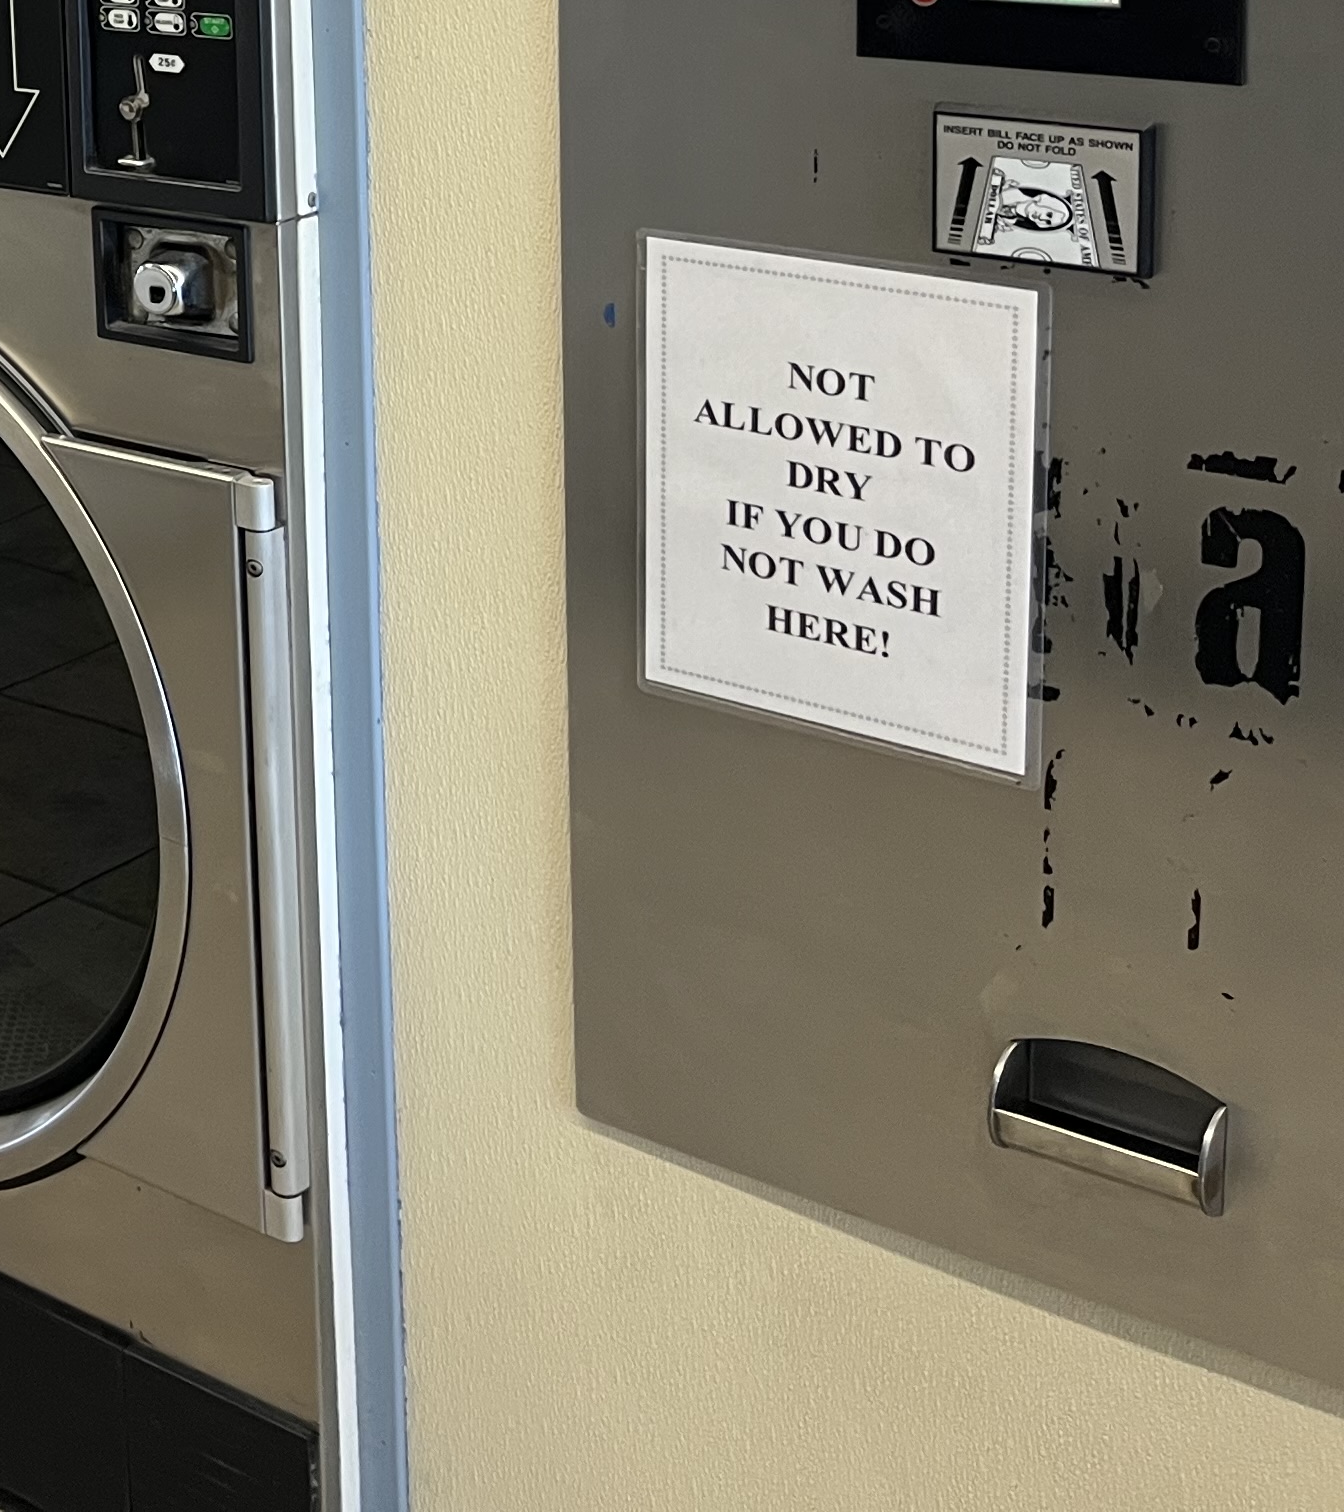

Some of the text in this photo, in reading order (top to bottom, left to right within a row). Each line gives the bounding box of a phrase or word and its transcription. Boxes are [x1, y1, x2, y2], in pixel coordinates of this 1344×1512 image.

[943, 125, 1134, 151] INSERT BILL FACE UP AS SHOWN
[997, 140, 1076, 157] DO NOT FOLD
[984, 184, 999, 225] DOLLAR
[787, 361, 876, 403] NOT
[693, 398, 976, 474] ALLOWED TO
[785, 461, 872, 504] DRY
[725, 499, 937, 568] IF YOU DO
[721, 544, 943, 620] NOT WASH
[765, 604, 893, 659] HERE!
